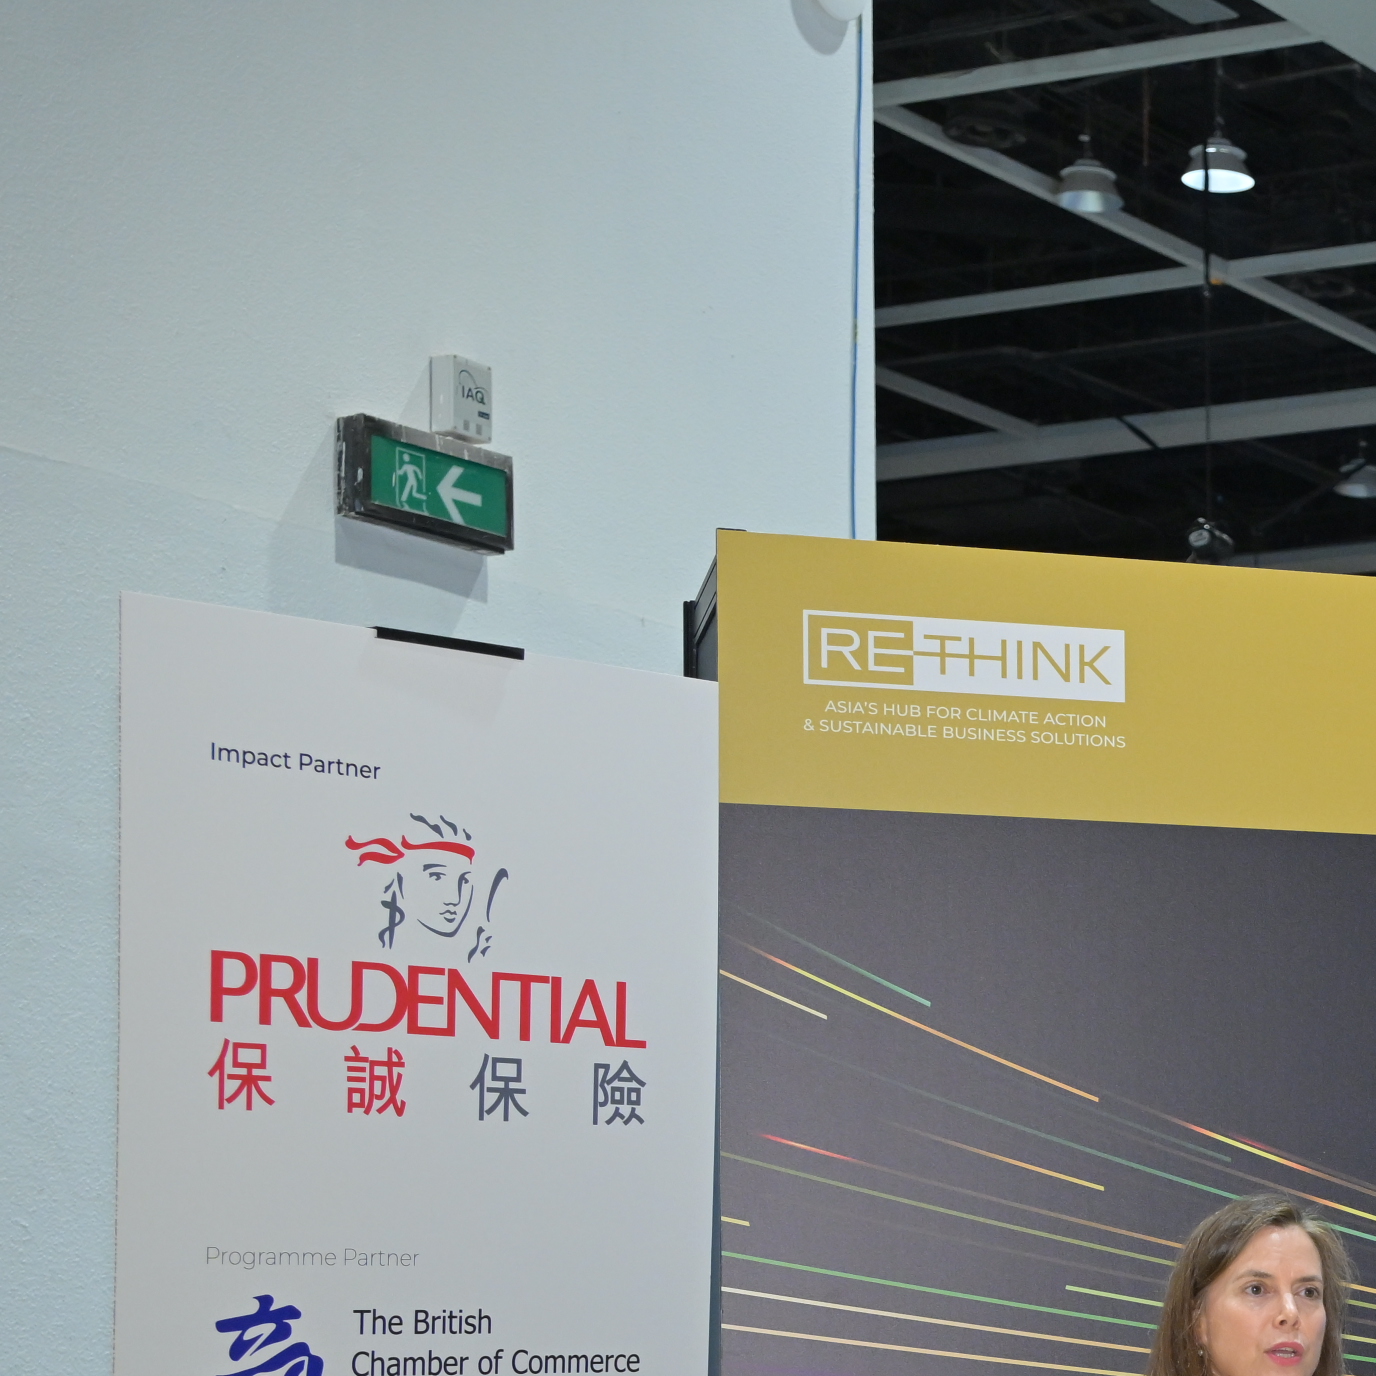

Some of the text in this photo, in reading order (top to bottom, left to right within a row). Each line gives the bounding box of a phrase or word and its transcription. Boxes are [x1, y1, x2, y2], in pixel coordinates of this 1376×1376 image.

[462, 385, 486, 405] IAQ
[825, 700, 1107, 729] ASIA'S HUB FOR CLIMATE ACTION
[803, 718, 1126, 749] & SUSTAINABLE BUSINESS SOLUTIONS
[210, 742, 381, 780] Impact Partner
[209, 949, 647, 1049] PRUDENTIAL
[208, 1038, 647, 1126] 保誠保險
[205, 1246, 419, 1270] Programme Partner
[353, 1308, 492, 1335] The British
[478, 1349, 503, 1375] of
[511, 1349, 641, 1376] Commerce
